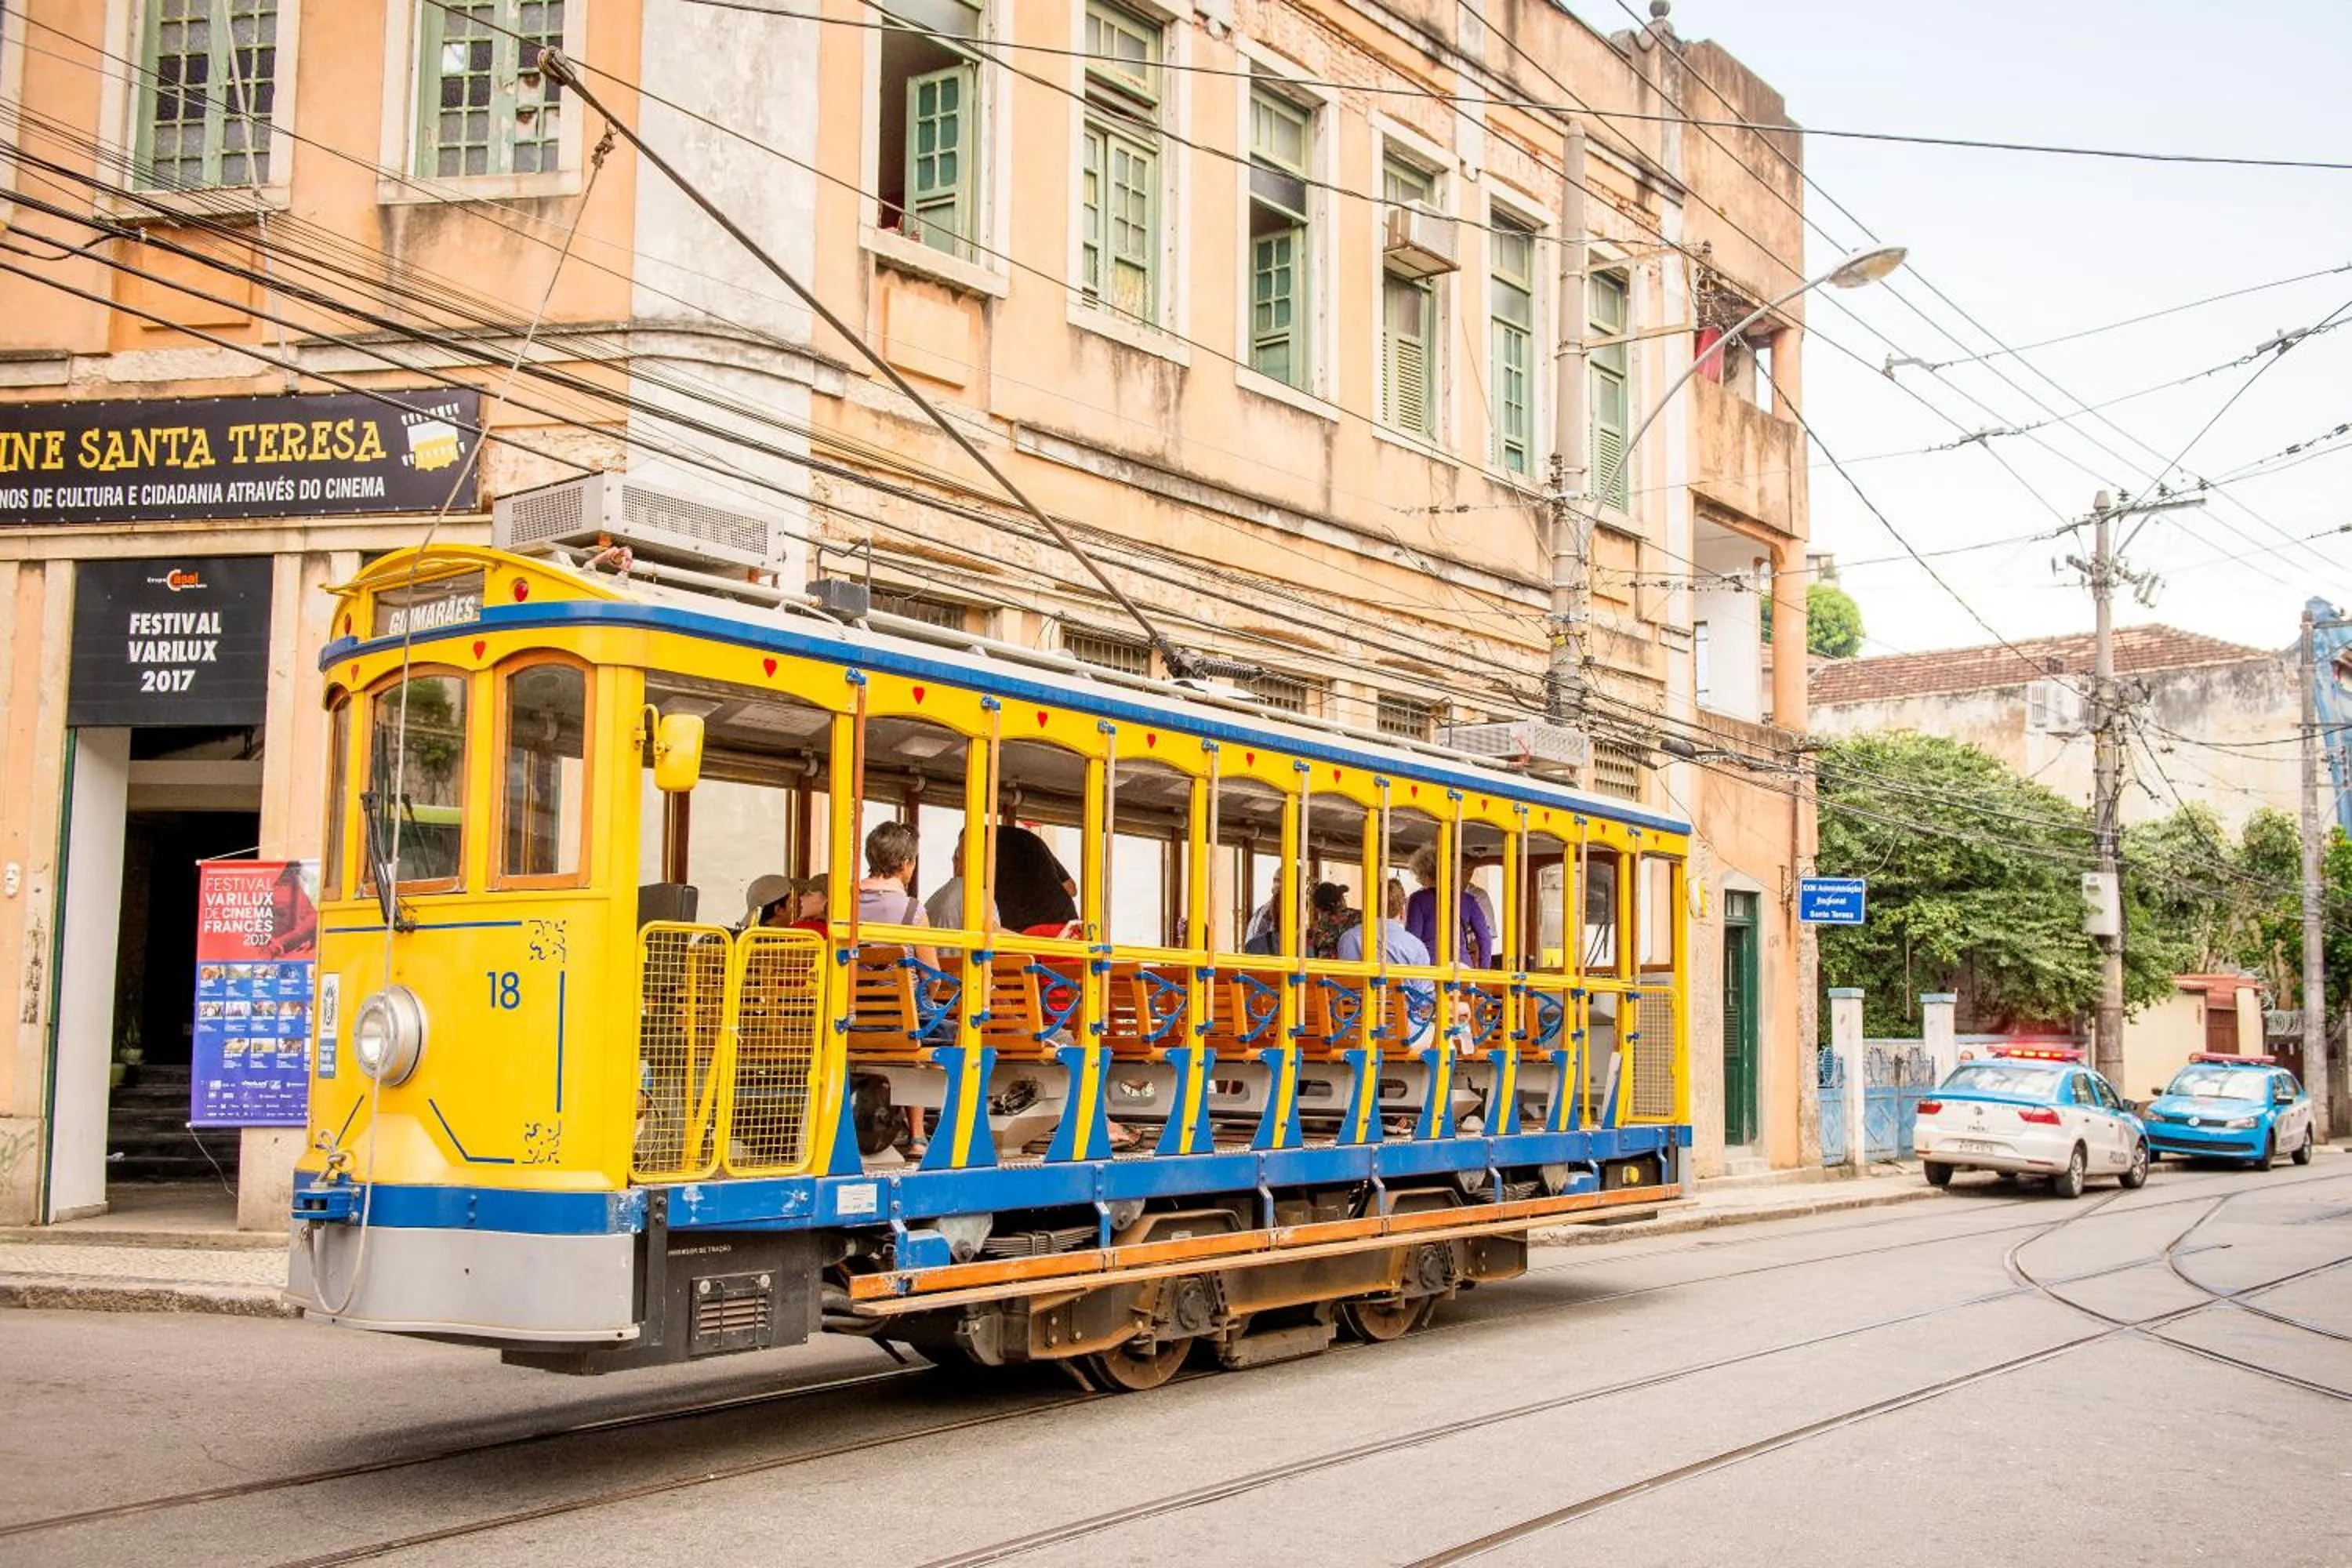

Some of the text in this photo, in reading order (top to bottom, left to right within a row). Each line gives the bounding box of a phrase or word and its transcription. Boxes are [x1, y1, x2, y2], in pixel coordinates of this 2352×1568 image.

[78, 426, 216, 470] SANTA
[228, 419, 387, 463] TERESA
[33, 488, 53, 508] DE
[56, 485, 124, 508] CULTURA
[128, 485, 138, 506] E
[142, 482, 223, 506] CIDADANIA
[227, 474, 295, 503] ATRAVÉS
[299, 478, 321, 500] DO
[325, 476, 385, 499] CINEMA
[128, 612, 222, 635] FESTIVAL
[389, 595, 477, 634] GUIMARÃES
[127, 640, 219, 663] VARILUX
[140, 669, 195, 692] 2017
[205, 877, 274, 891] FESTIVAL
[205, 891, 274, 906] VARILUX
[205, 906, 274, 920] DE CINEMA
[204, 918, 274, 933] FRANCÊS
[242, 934, 272, 947] 2017
[487, 971, 521, 1010] 18
